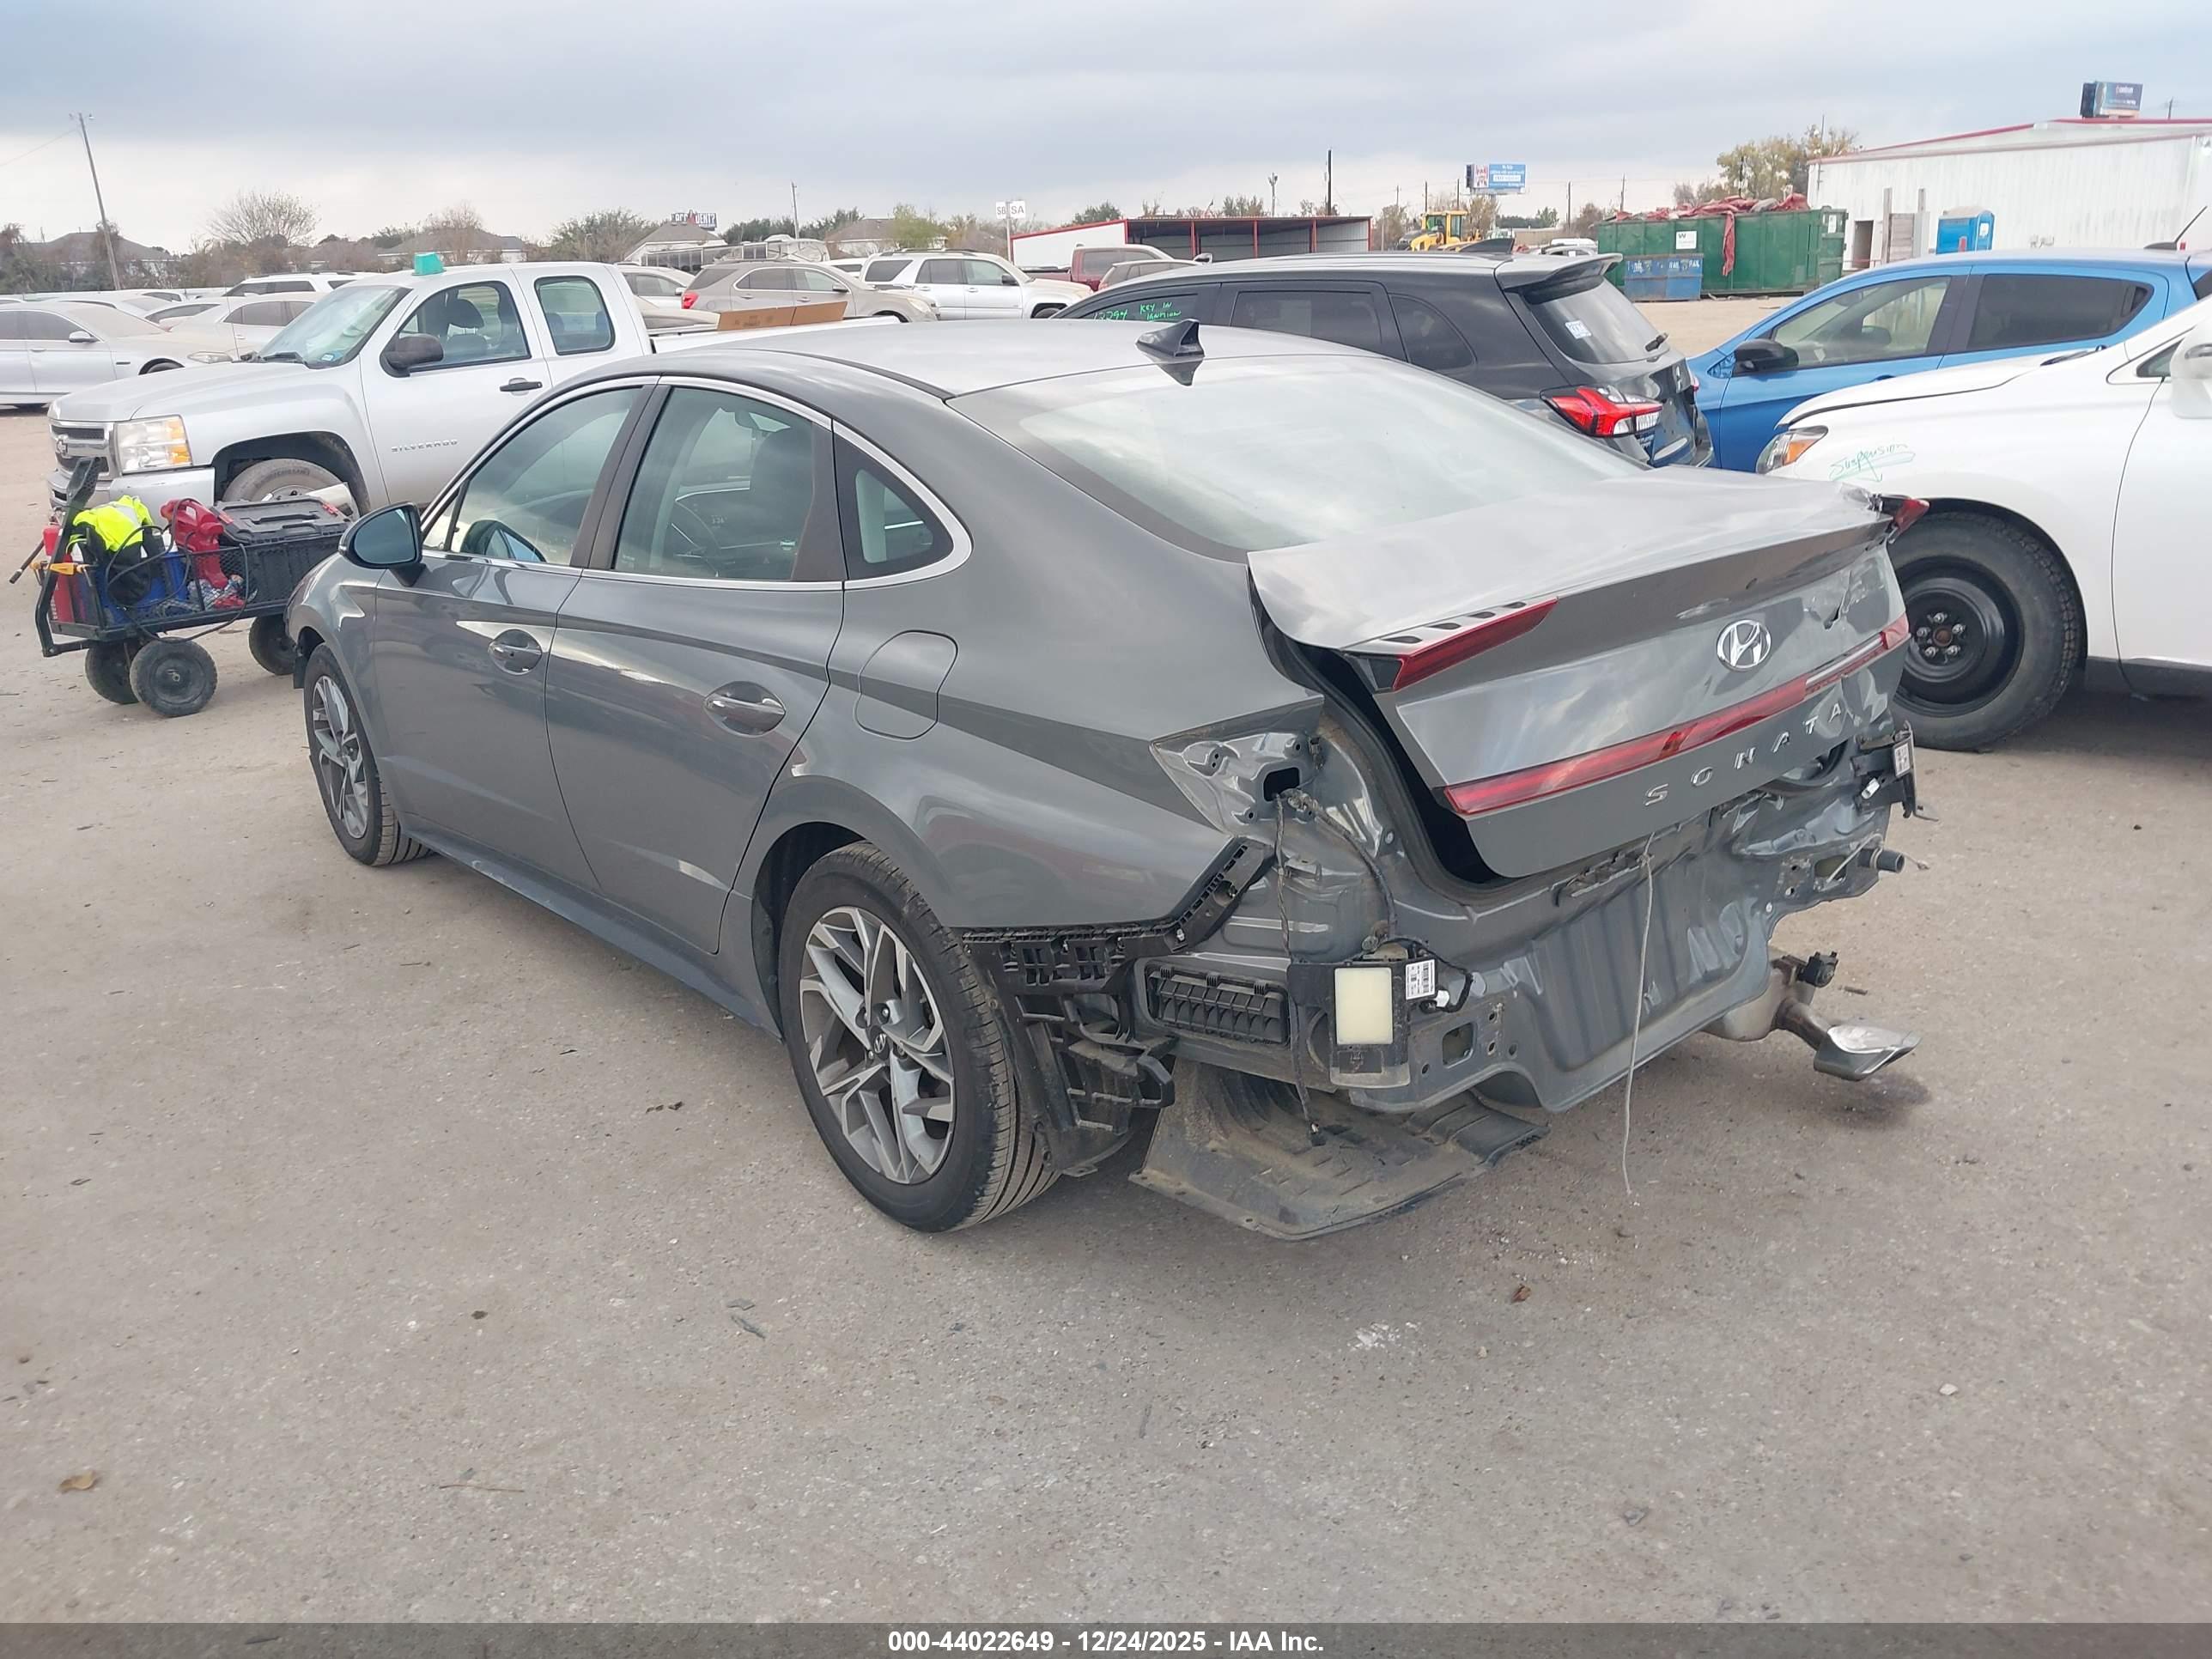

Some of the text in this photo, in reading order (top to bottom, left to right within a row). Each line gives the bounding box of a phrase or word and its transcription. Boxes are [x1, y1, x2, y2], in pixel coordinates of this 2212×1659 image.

[1011, 205, 1024, 215] SA
[675, 212, 715, 224] ACCDENT?
[391, 439, 459, 453] SILVERADO
[1644, 702, 1842, 806] SONATA
